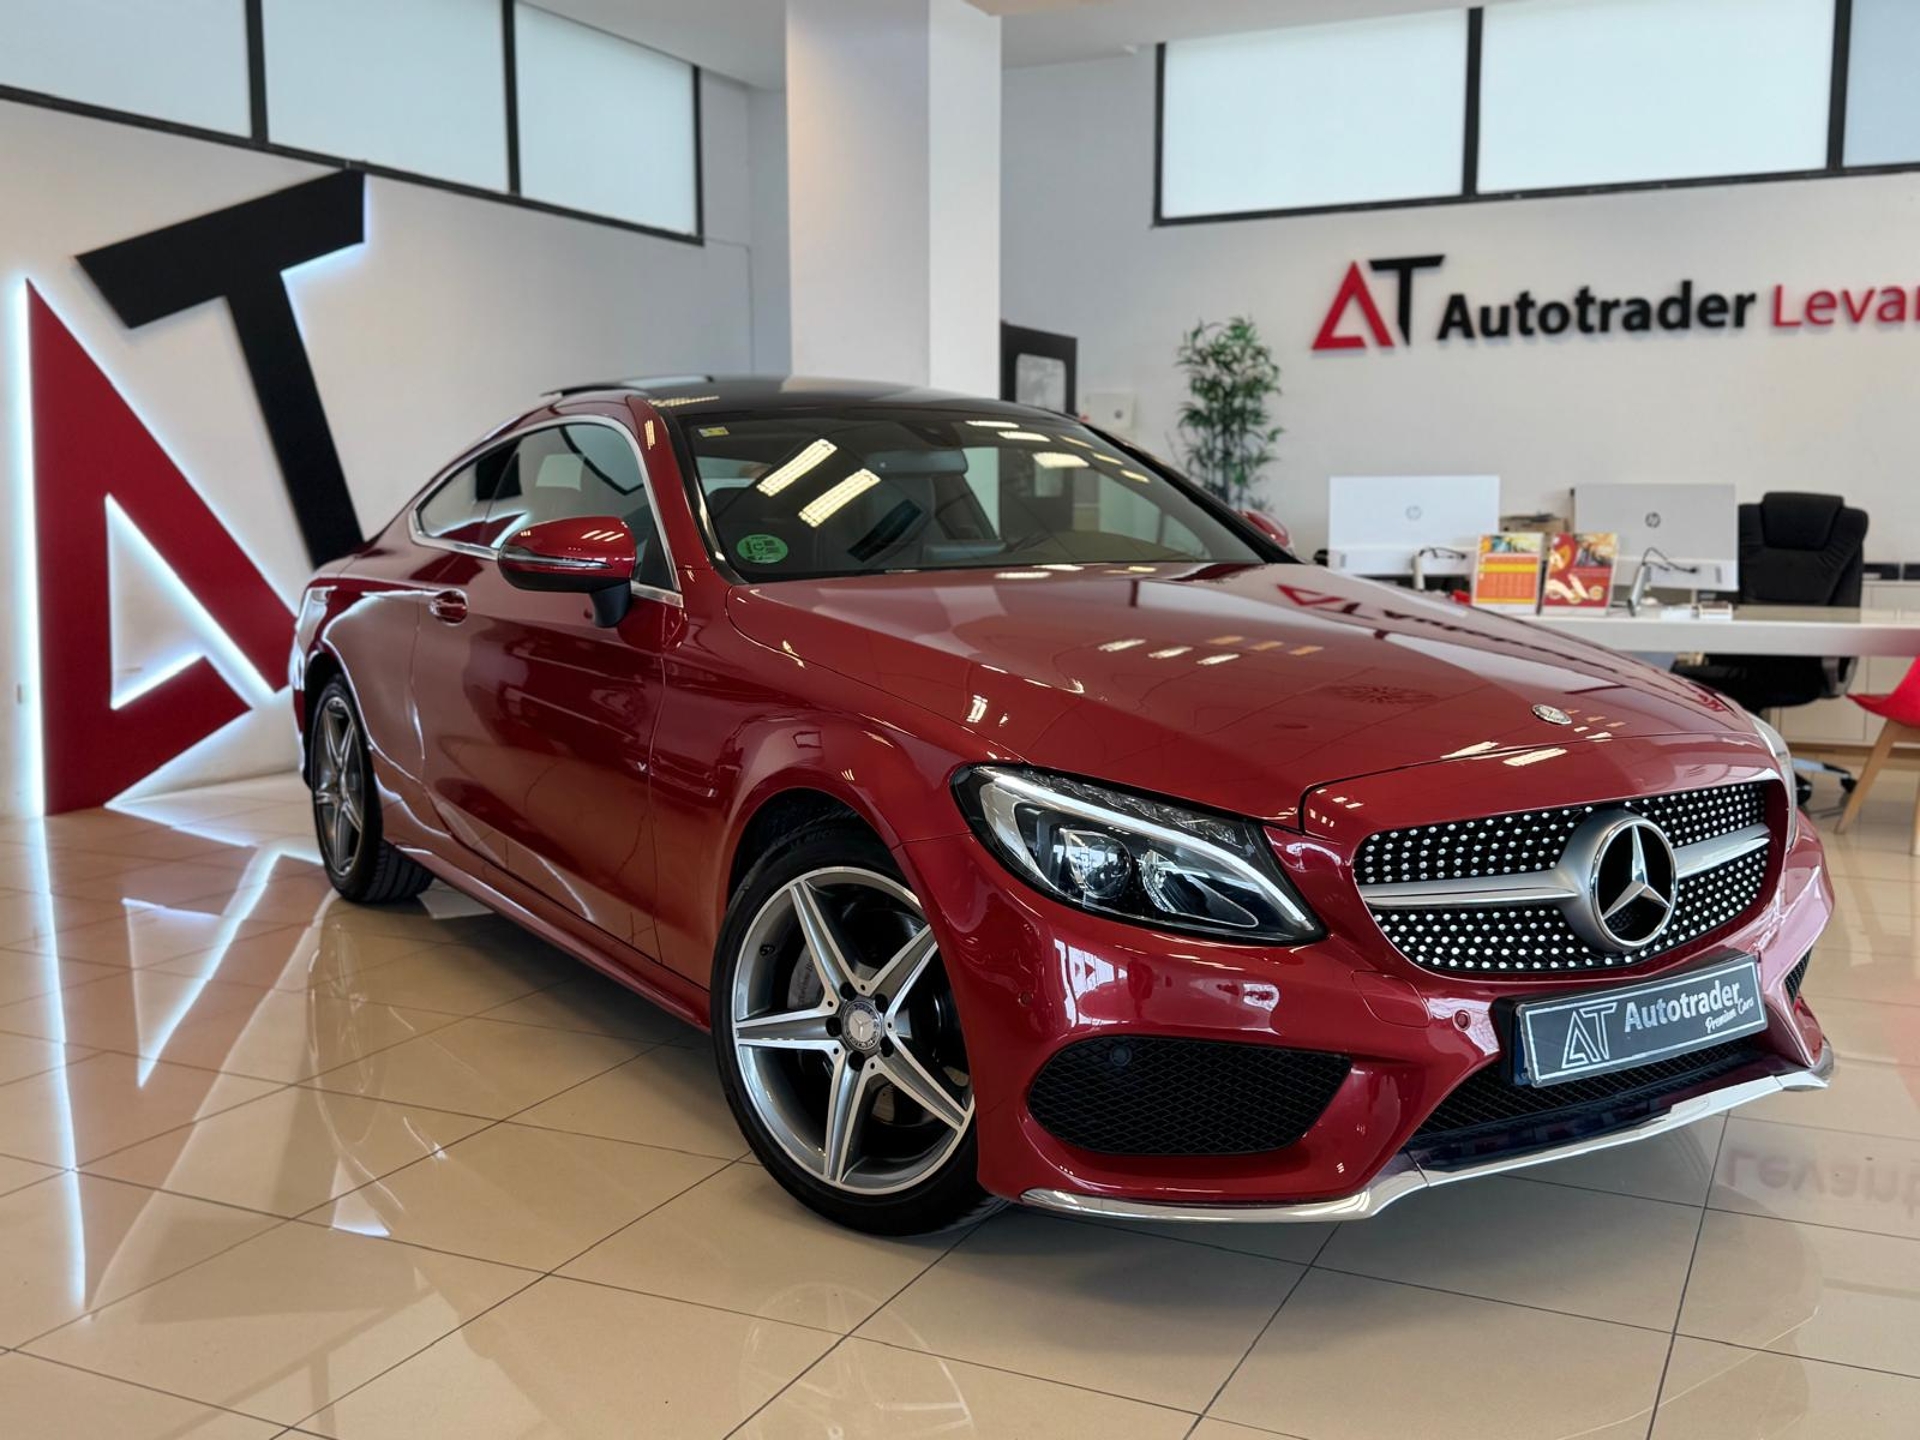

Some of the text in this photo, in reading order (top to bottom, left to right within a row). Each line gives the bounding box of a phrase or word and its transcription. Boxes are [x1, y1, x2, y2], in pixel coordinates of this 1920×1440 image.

[1311, 254, 1920, 350] AT Autotrader Leva
[26, 169, 364, 815] AT
[1561, 980, 1741, 1069] AT Autotrader
[1705, 996, 1755, 1034] Premium Cars
